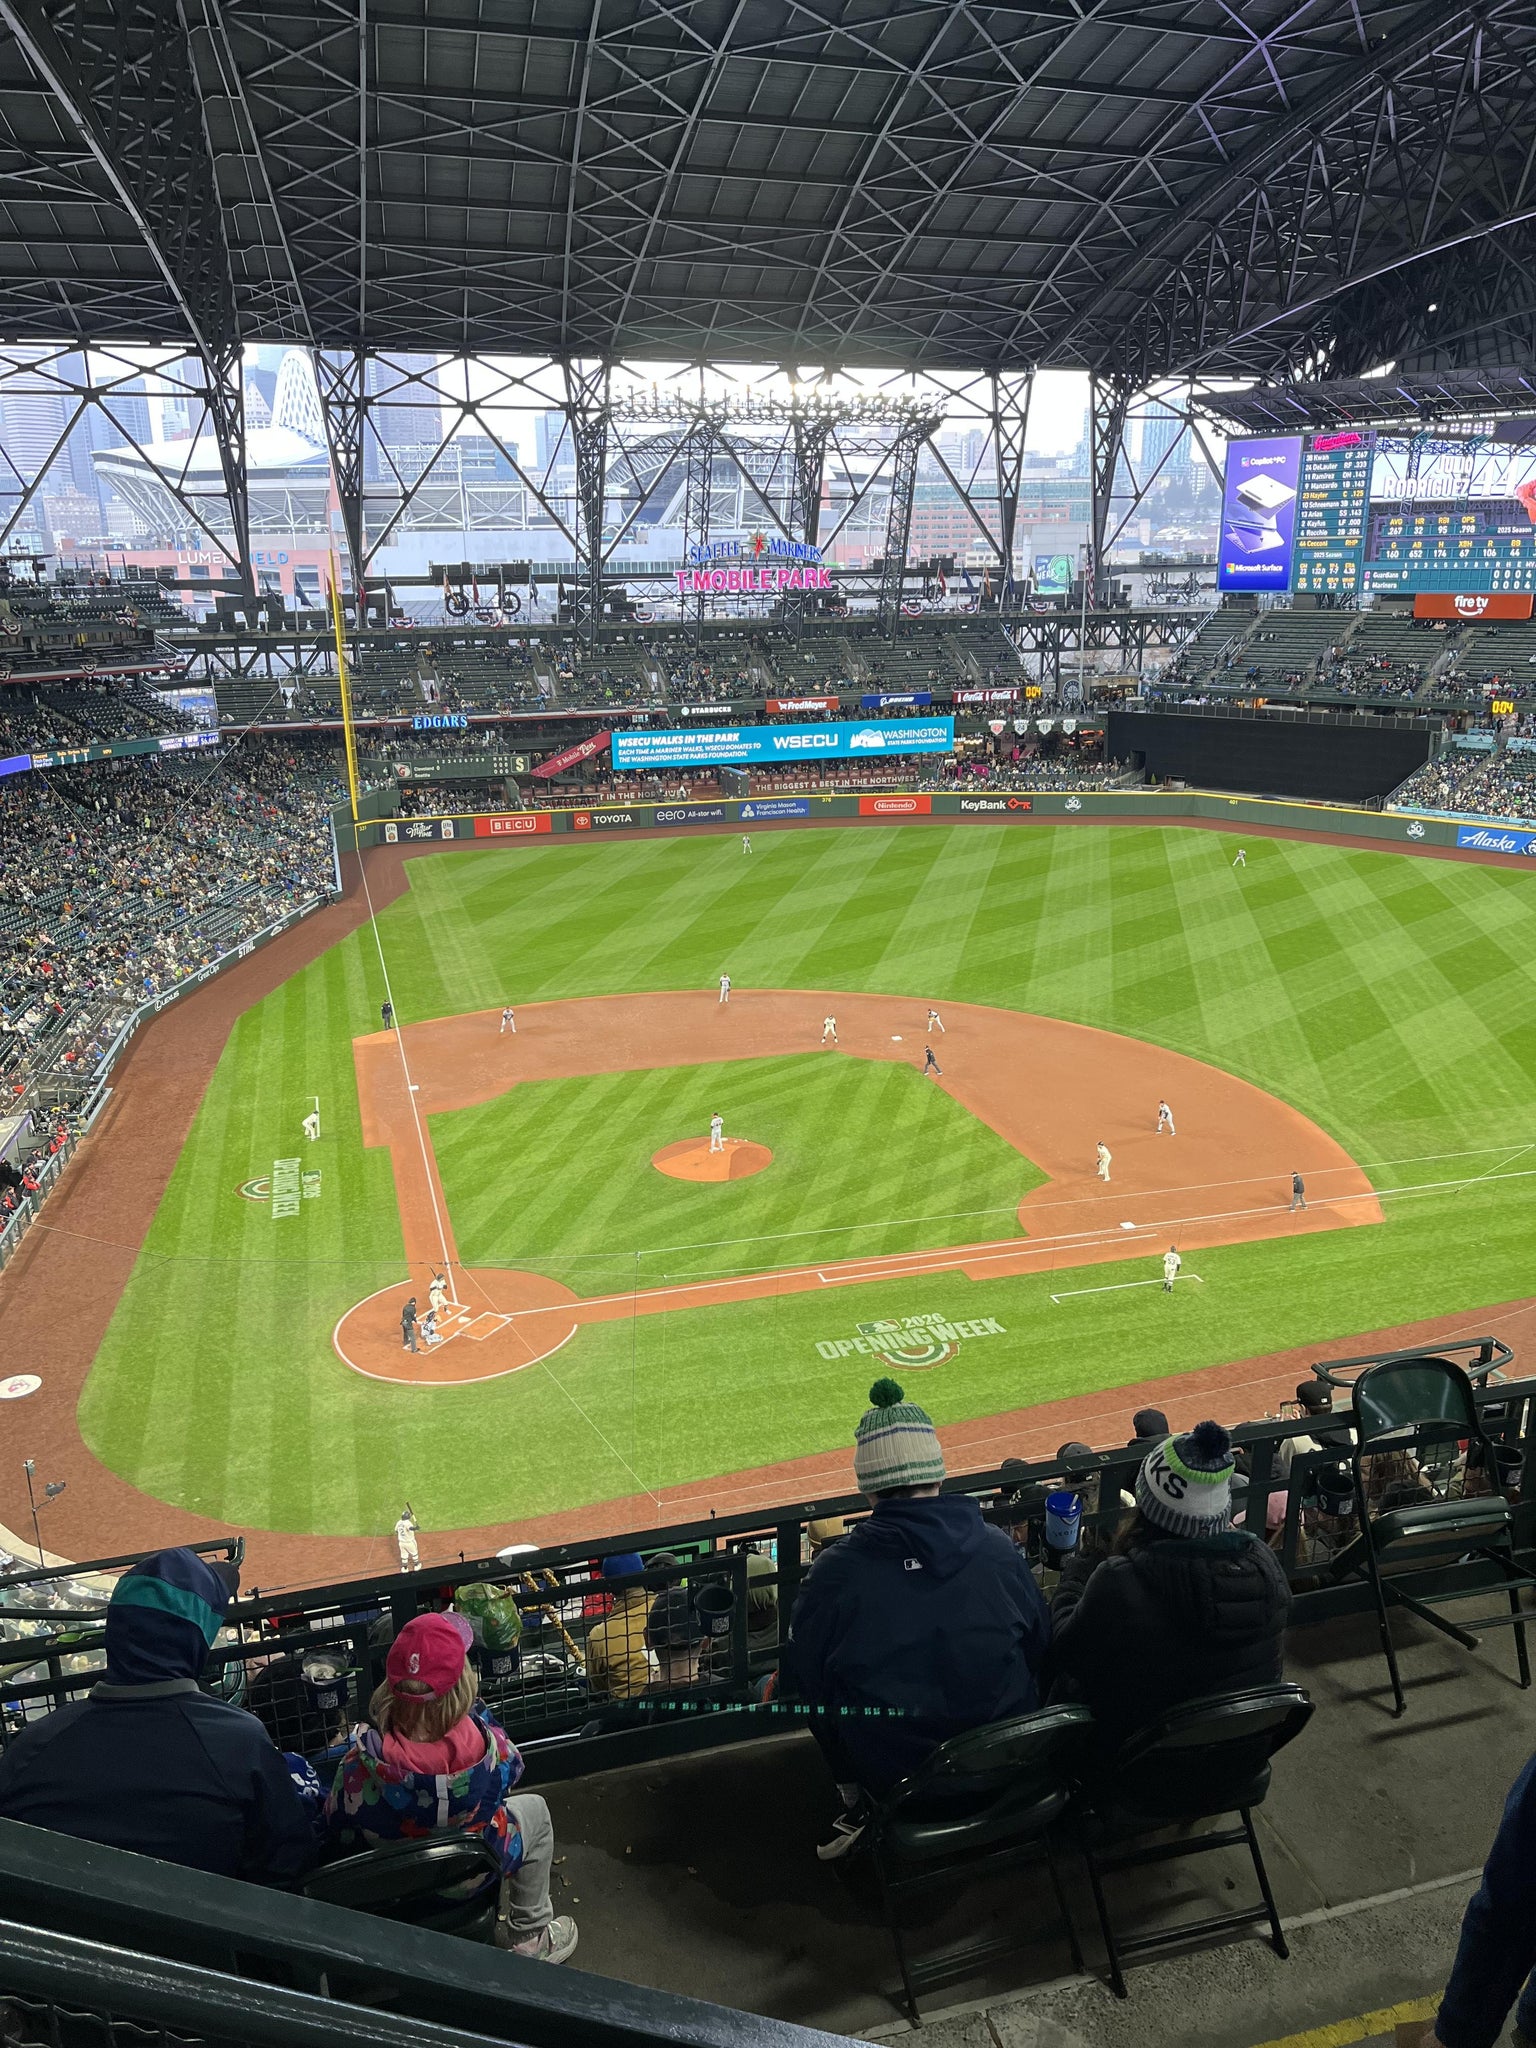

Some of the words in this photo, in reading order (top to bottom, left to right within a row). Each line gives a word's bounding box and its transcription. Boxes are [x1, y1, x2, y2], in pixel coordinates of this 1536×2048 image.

[1312, 463, 1338, 471] DeLauter
[1471, 456, 1520, 497] 44
[1348, 518, 1361, 526] .000
[1462, 516, 1476, 524] OPS
[1388, 526, 1403, 535] .267
[1414, 526, 1424, 534] 32
[1438, 526, 1448, 534] 95
[1459, 525, 1476, 534] .798
[690, 540, 740, 564] SEATTLE
[770, 538, 823, 563] MARINERS
[1386, 550, 1400, 558] 160
[1408, 550, 1423, 558] 652
[1459, 548, 1470, 558] 67
[1483, 548, 1497, 557] 106
[1236, 564, 1261, 572] Microsoft
[1262, 564, 1283, 572] Surface
[673, 568, 772, 592] T-MOBILE
[777, 567, 832, 589] PARK
[1402, 570, 1408, 579] 0
[1494, 570, 1500, 579] 0
[1504, 570, 1510, 579] 0
[1515, 570, 1521, 579] 0
[1492, 580, 1498, 589] 0
[1503, 580, 1509, 589] 0
[1514, 580, 1520, 589] 0
[74, 598, 90, 606] Deck
[1454, 596, 1475, 607] fire
[1476, 596, 1488, 607] tv
[691, 706, 732, 714] STARBUCKS
[1492, 700, 1514, 714] 0:04
[413, 715, 468, 730] EDGARS
[883, 728, 947, 739] WASHINGTON
[618, 737, 650, 748] WSECU
[652, 735, 684, 746] WALKS
[684, 734, 696, 744] IN
[697, 734, 714, 744] THE
[714, 732, 740, 743] PARK
[773, 734, 838, 750] WSECU
[683, 746, 704, 754] WALKS,
[619, 756, 630, 764] THE
[631, 754, 672, 762] WASHINGTON
[516, 757, 524, 772] S
[756, 784, 772, 792] THE
[774, 782, 810, 790] BIGGEST
[819, 778, 838, 787] BEST
[869, 776, 920, 784] NORTHWEST
[618, 792, 635, 800] THE
[877, 801, 915, 809] Nintendo
[961, 800, 1006, 811] KeyBank
[594, 814, 632, 824] TOYOTA
[657, 810, 685, 820] eero
[688, 810, 710, 818] All-star
[494, 818, 534, 831] BECU
[1411, 824, 1422, 832] 50
[1462, 830, 1516, 851] Alaska
[238, 940, 256, 958] STIHL
[901, 1312, 946, 1329] 2026
[815, 1327, 934, 1360] OPENING
[928, 1317, 1007, 1342] WEEK
